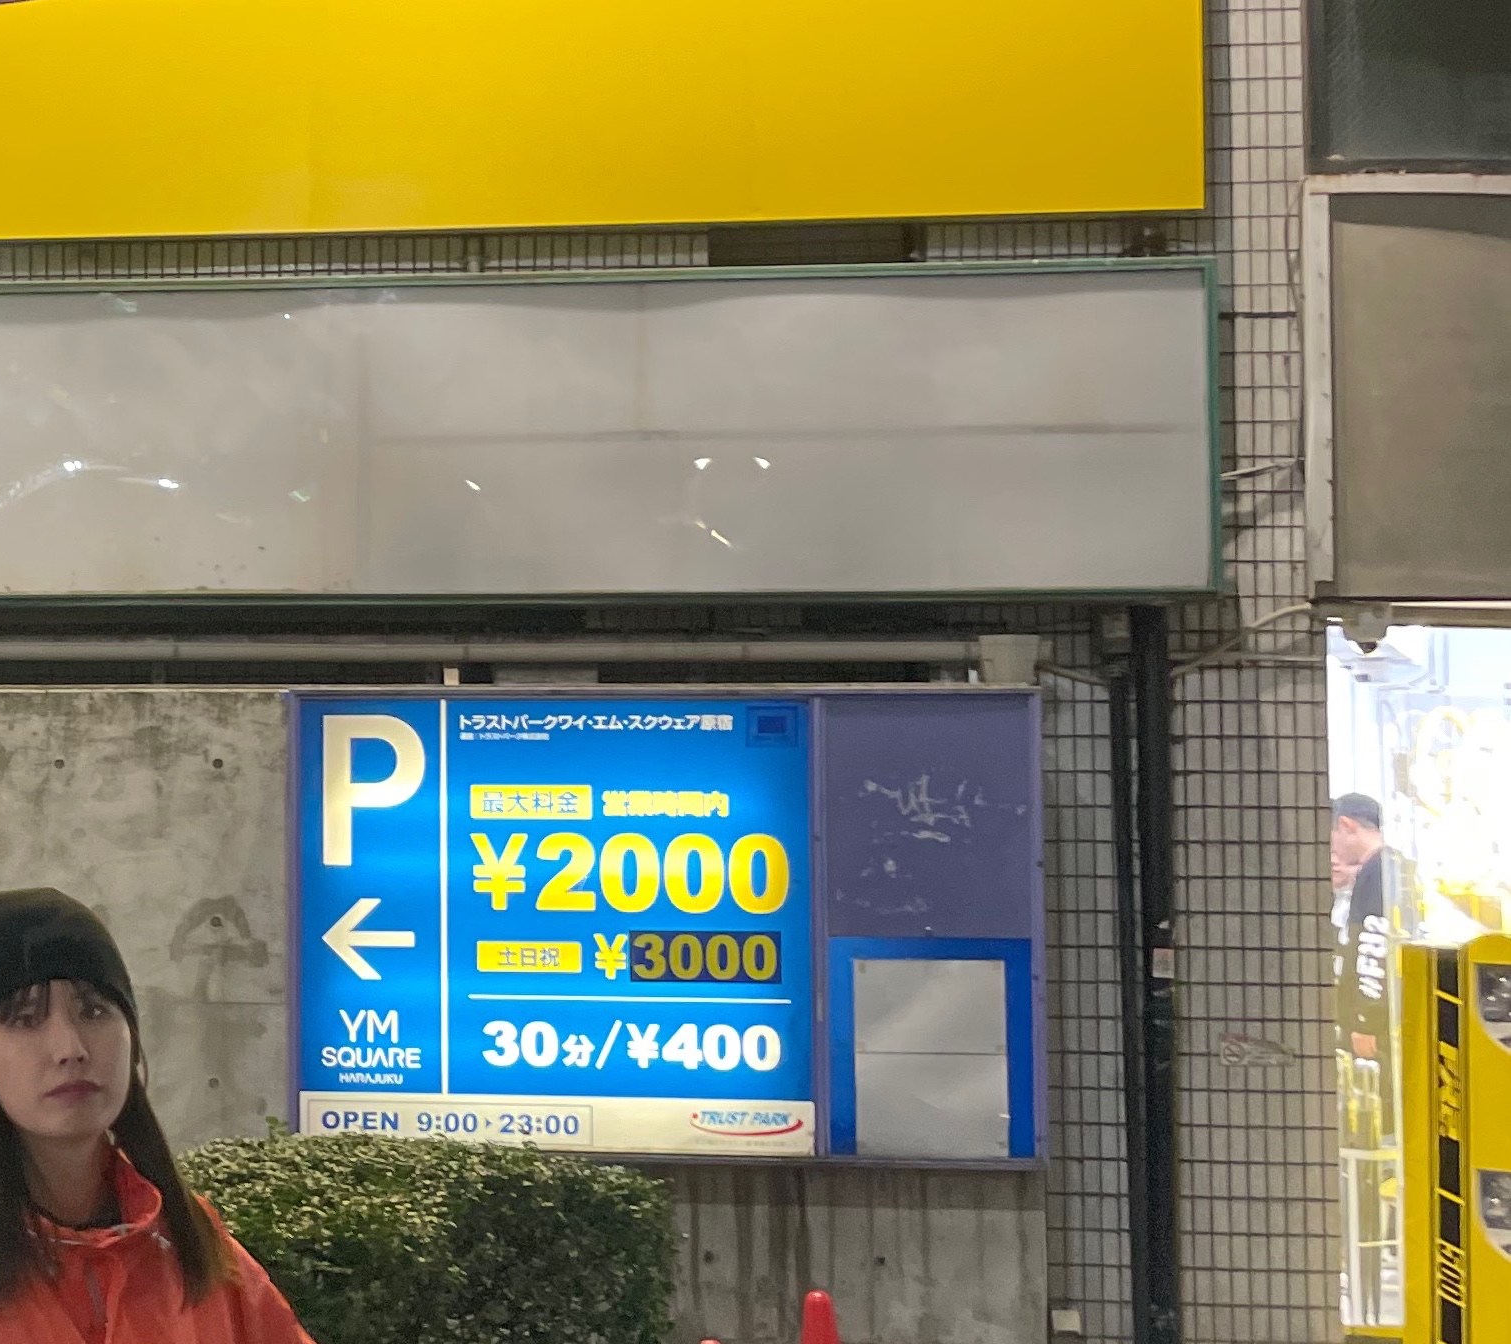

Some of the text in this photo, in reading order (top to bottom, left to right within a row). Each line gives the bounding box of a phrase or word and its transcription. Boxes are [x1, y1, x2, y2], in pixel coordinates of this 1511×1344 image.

[322, 714, 425, 866] P
[481, 790, 579, 813] 最大料金
[470, 832, 790, 914] ¥2000
[497, 933, 779, 981] 土日祝 ¥3000
[338, 1009, 400, 1044] YM
[321, 1046, 422, 1069] SQUARE
[338, 1072, 404, 1085] HARAJUKU
[321, 1110, 580, 1135] OPEN 9:00 23:00
[699, 1110, 792, 1126] TRUST PARK
